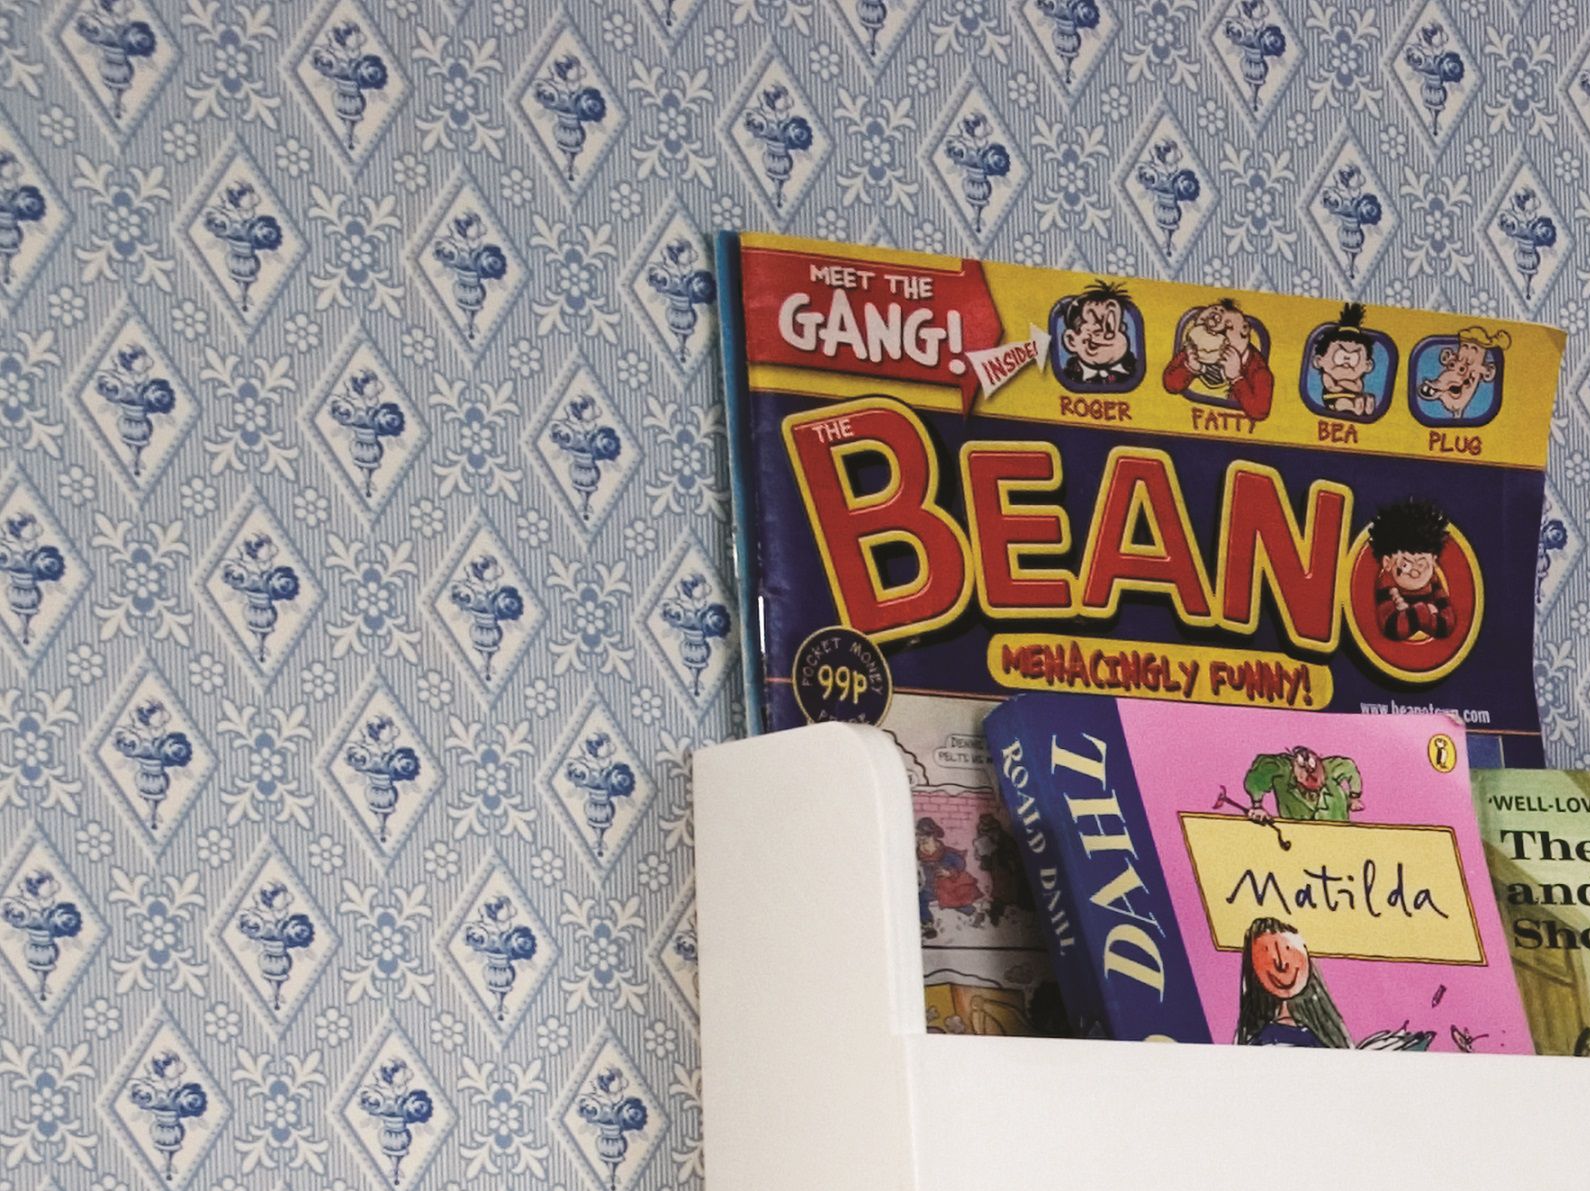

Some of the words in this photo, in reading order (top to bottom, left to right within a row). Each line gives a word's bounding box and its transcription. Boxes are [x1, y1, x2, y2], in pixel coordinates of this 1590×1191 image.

[810, 264, 875, 290] MEET
[884, 274, 934, 299] THE
[778, 288, 966, 375] GANG!
[982, 341, 1039, 385] INSIDE!
[812, 418, 854, 443] THE
[1060, 396, 1132, 421] ROGER
[1191, 408, 1258, 434] FATTY
[1318, 420, 1359, 444] BEA
[1429, 430, 1482, 455] PLUG
[782, 396, 1484, 684] BEANO
[801, 637, 841, 687] POCKET
[850, 641, 883, 696] MONEY
[818, 664, 868, 704] 99p
[1001, 641, 1199, 697] MENACINGLY
[1210, 661, 1314, 706] FUNNY!
[1001, 737, 1047, 855] ROALD
[1040, 867, 1076, 956] DAHL
[1051, 733, 1166, 1003] DAHL
[1226, 859, 1449, 919] Matilda
